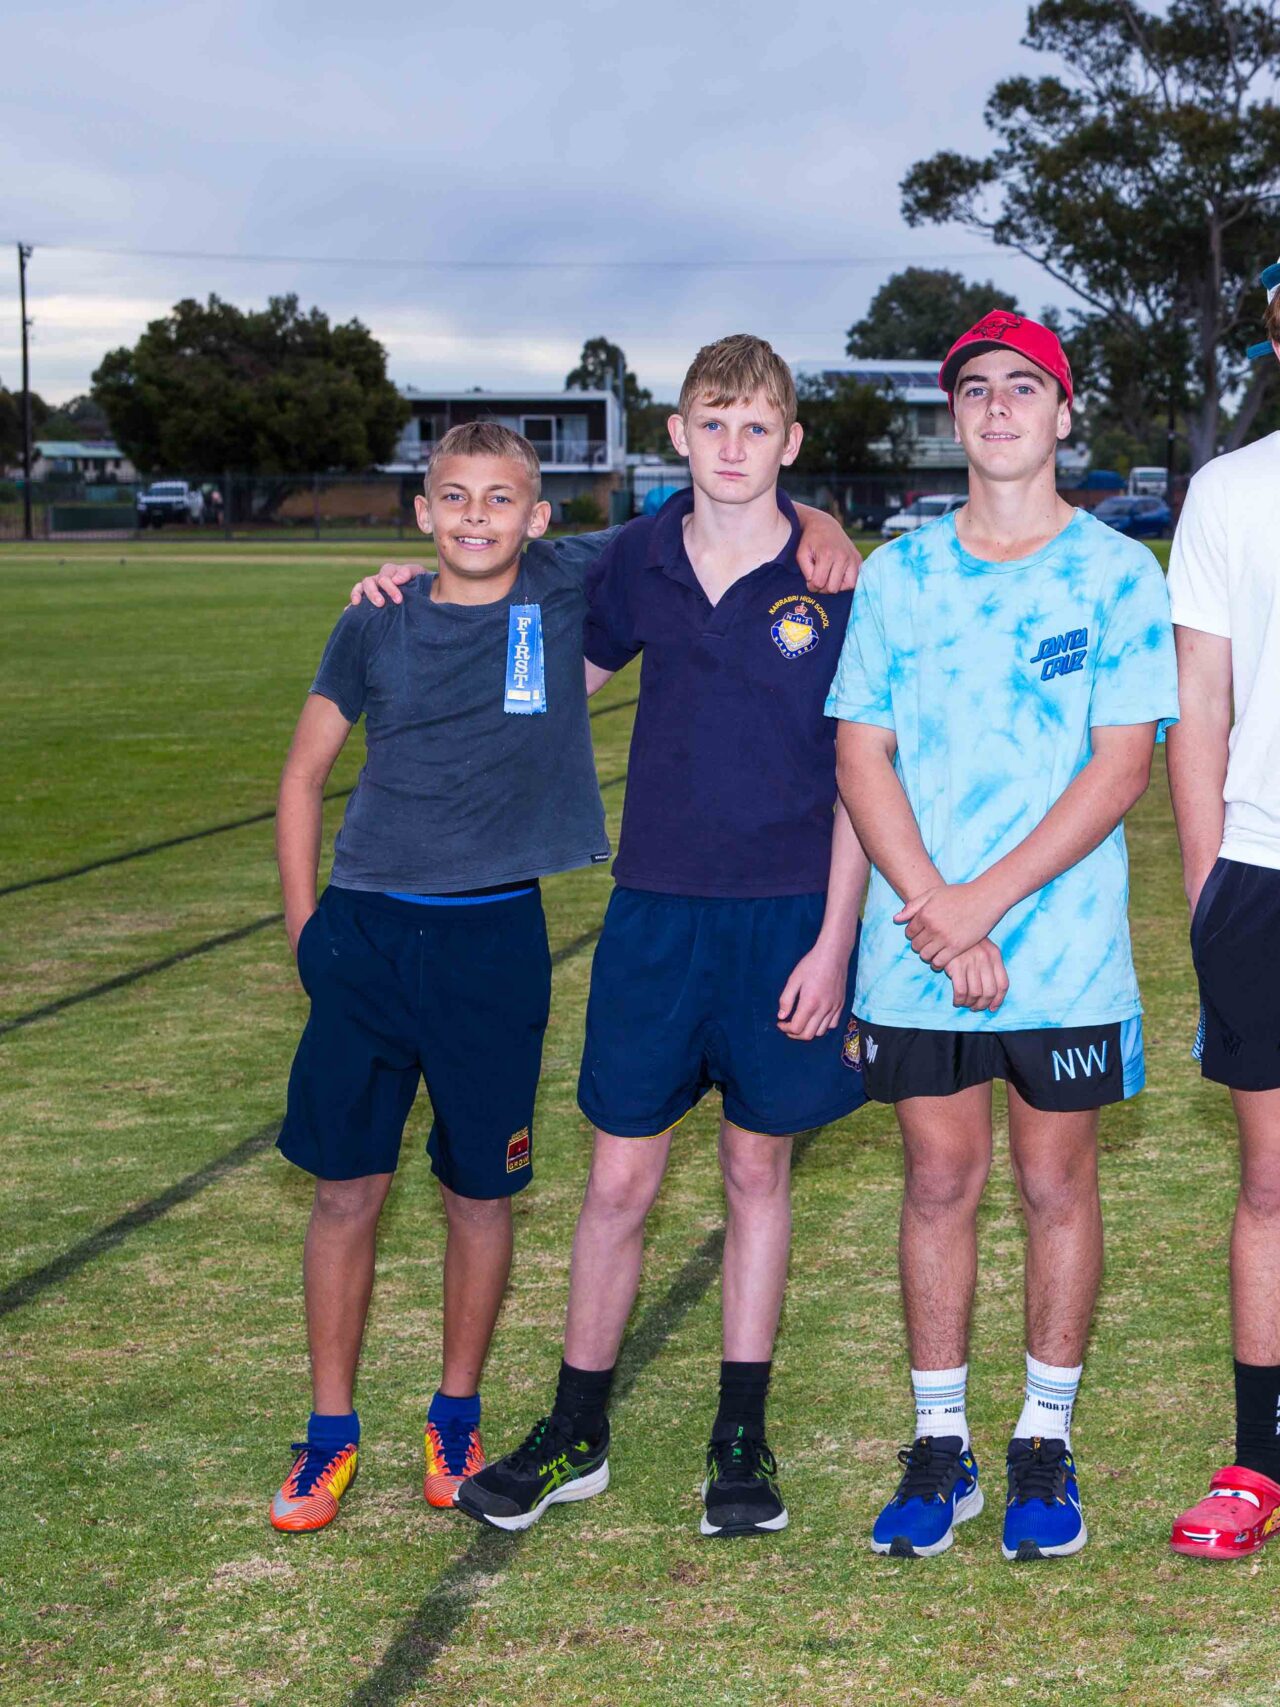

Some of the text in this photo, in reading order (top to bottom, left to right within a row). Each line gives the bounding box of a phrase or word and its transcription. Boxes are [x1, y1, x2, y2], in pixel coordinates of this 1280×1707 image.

[768, 595, 830, 630] NARRABRI HIGH SCHOOL
[513, 616, 532, 690] FIRST
[1030, 627, 1088, 664] SANTA
[1040, 649, 1088, 682] CRUZ
[1051, 1040, 1108, 1081] NW
